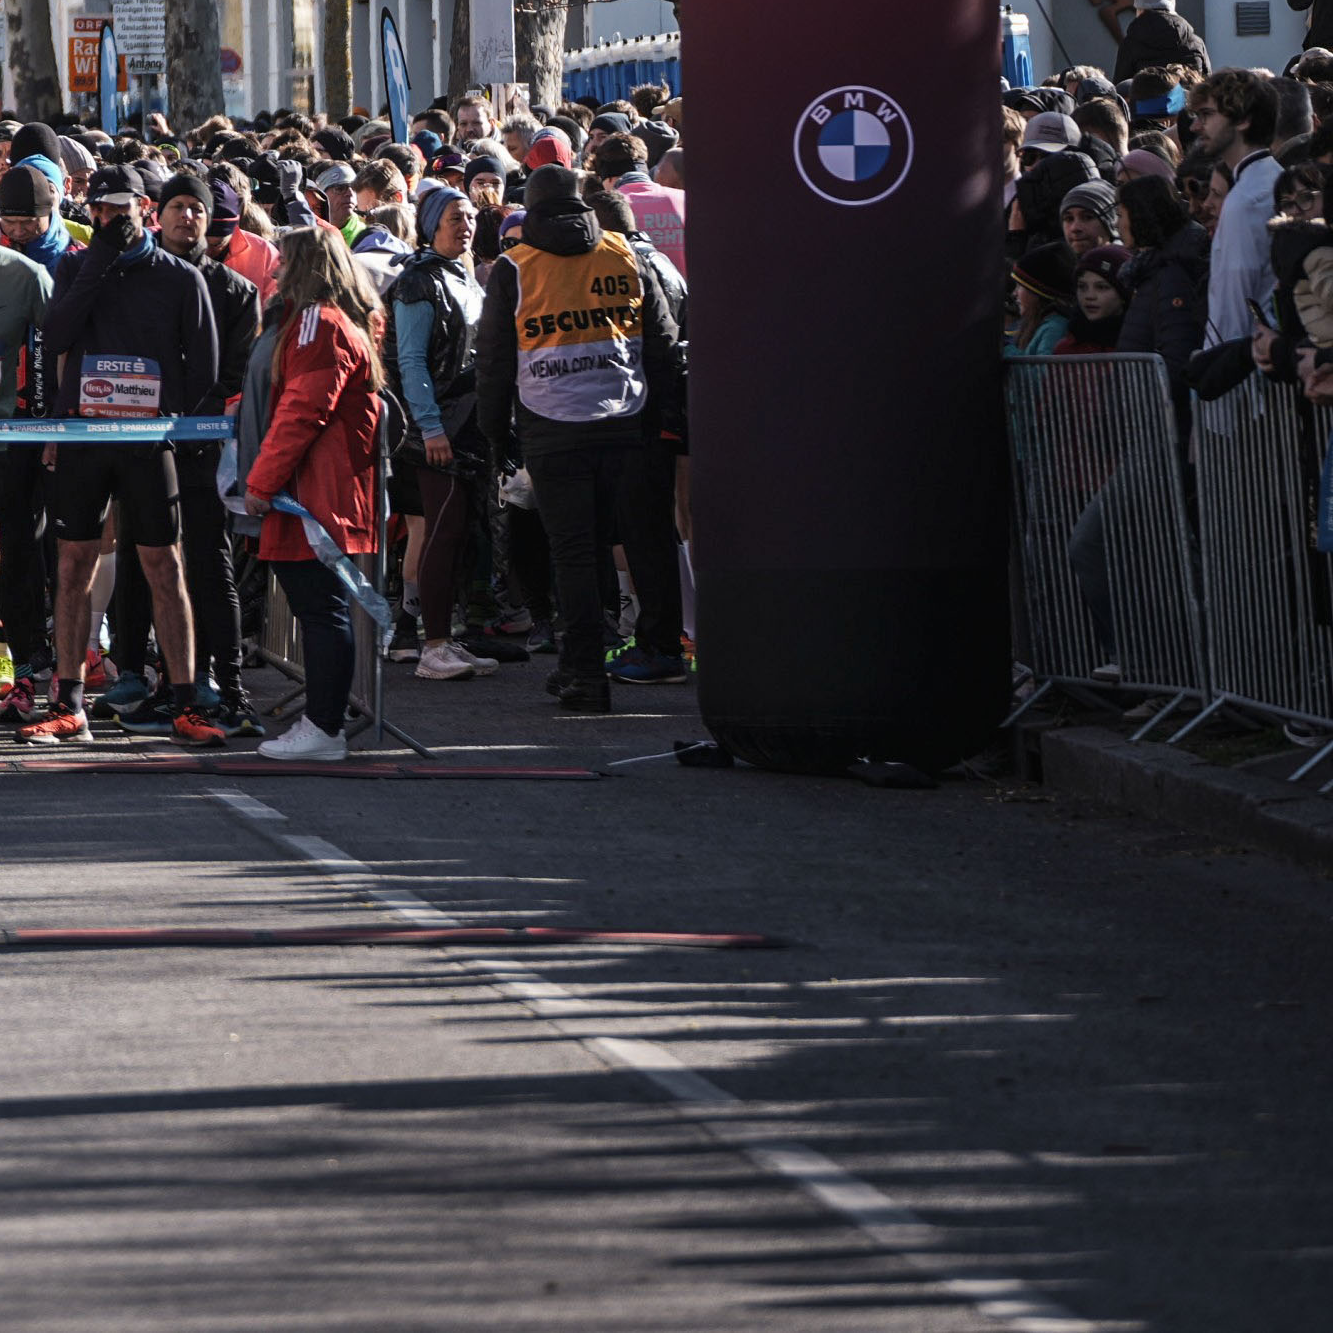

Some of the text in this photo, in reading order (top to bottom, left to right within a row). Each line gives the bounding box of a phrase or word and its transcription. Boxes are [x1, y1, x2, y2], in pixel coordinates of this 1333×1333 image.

[810, 91, 898, 126] BMW
[590, 276, 631, 296] 405
[96, 360, 131, 373] ERSTE
[528, 358, 571, 379] VIENNA
[573, 355, 598, 375] CITY
[114, 382, 156, 397] Matthieu
[121, 423, 169, 432] SPARKASSE
[196, 422, 220, 430] ERSTE
